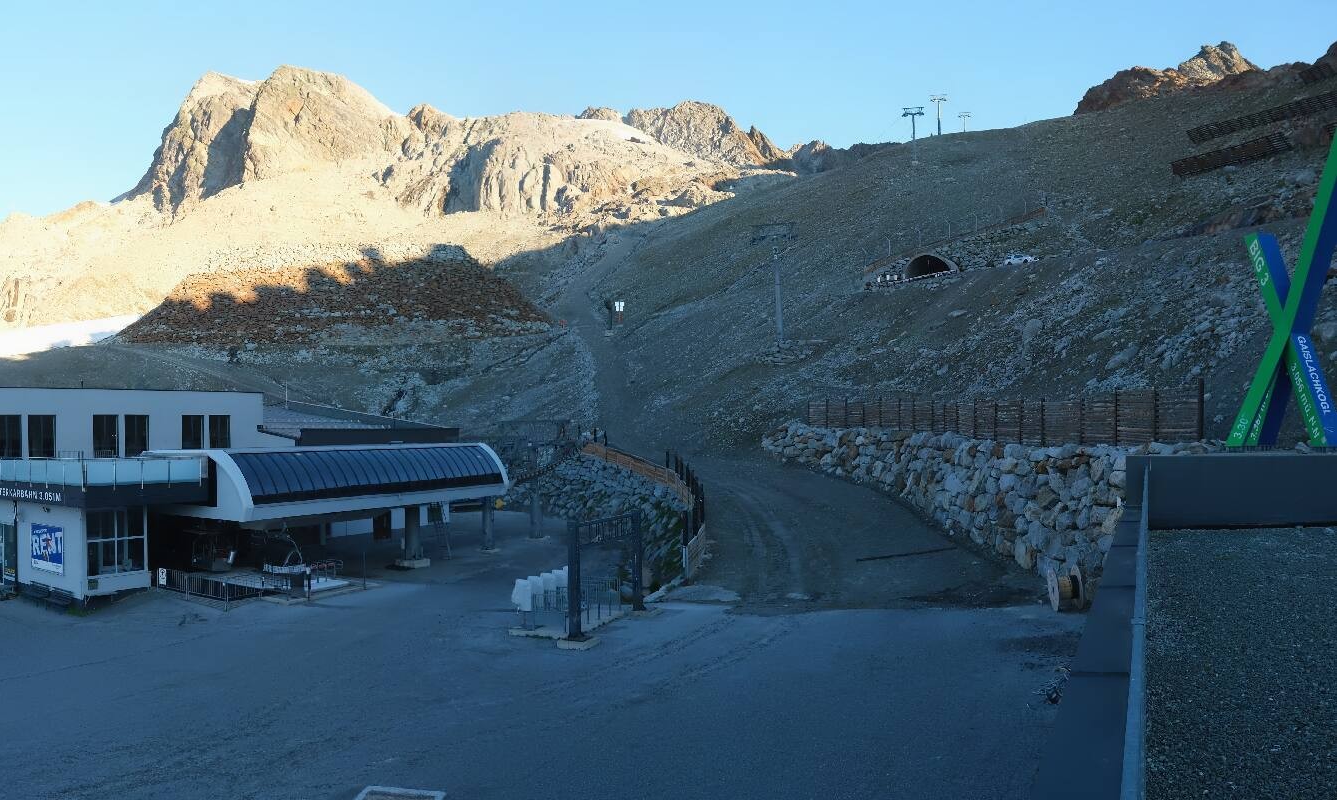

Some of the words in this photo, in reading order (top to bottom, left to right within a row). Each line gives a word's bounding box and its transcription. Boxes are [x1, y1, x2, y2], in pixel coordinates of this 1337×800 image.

[1249, 239, 1264, 272] BIG
[1260, 272, 1269, 286] 3
[1297, 335, 1331, 415] GAISLACHKOGL
[1233, 417, 1248, 440] 3.30
[31, 531, 63, 556] RENT
